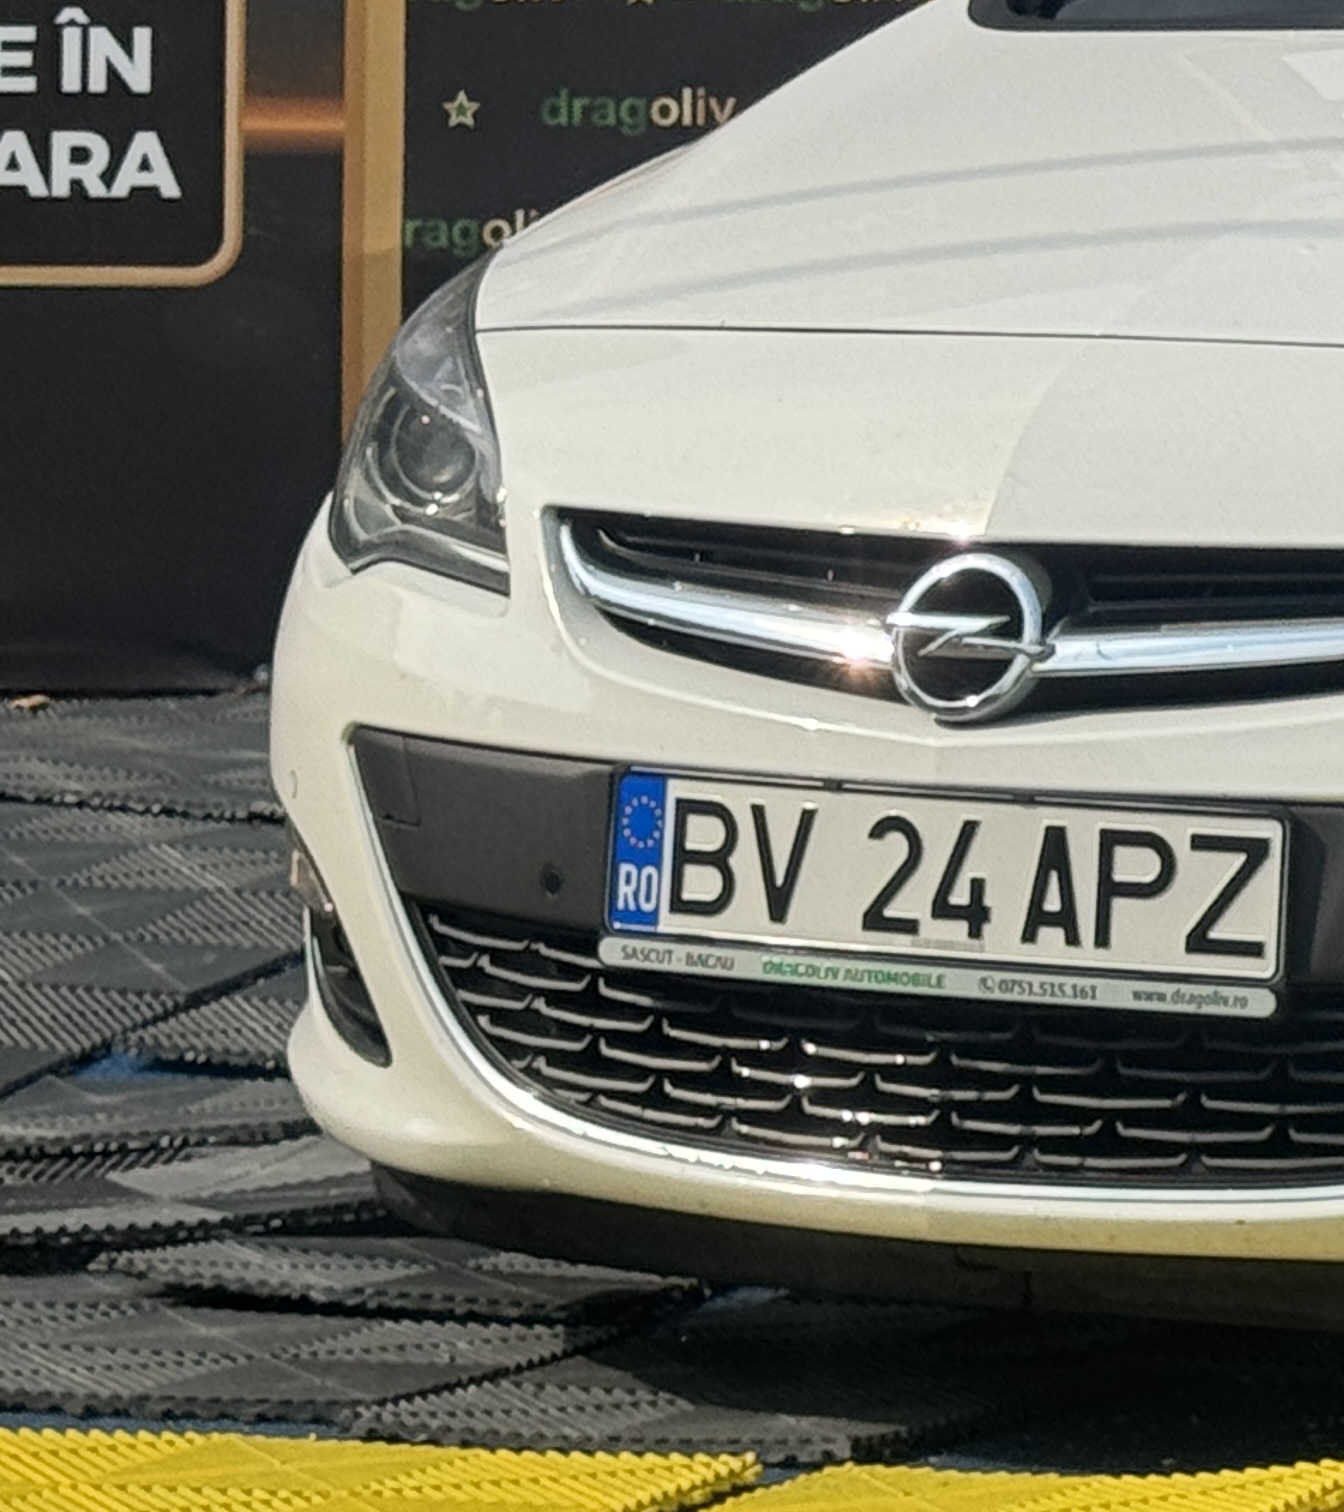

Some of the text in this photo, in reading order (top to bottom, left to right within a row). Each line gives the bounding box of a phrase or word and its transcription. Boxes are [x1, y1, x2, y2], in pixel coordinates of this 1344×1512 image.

[54, 6, 152, 93] ÎN
[541, 87, 737, 137] dragoliv
[0, 130, 182, 198] ARA
[616, 863, 659, 914] RO
[668, 797, 1273, 960] BV 24 APZ
[621, 944, 674, 966] SASCUT
[843, 967, 946, 990] AUTOMOBILE
